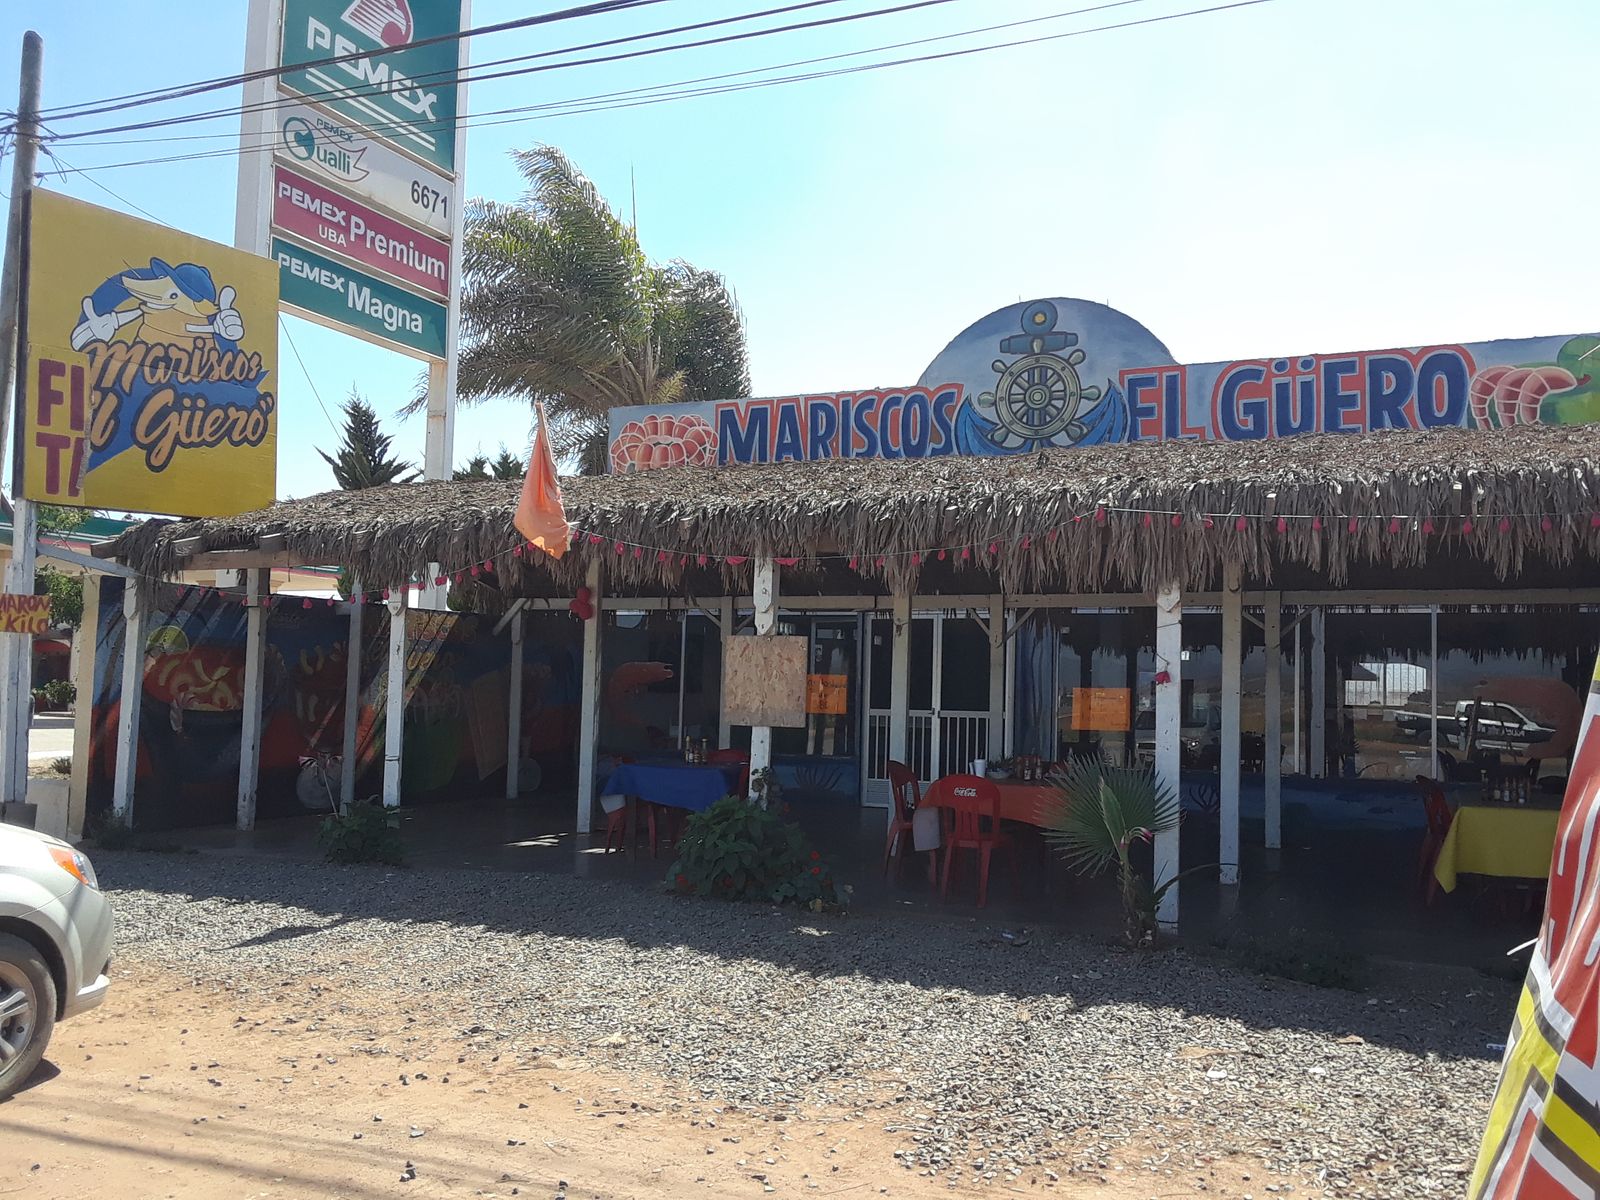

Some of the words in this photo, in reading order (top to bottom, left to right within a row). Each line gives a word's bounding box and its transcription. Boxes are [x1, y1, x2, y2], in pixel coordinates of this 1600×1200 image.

[307, 16, 437, 123] PEMEX
[316, 118, 354, 143] PEMEX
[278, 181, 347, 227] PEMEX
[350, 215, 446, 281] Premium
[318, 224, 347, 248] UBA
[411, 180, 449, 219] 6671
[278, 252, 345, 294] PEMEX
[347, 281, 423, 333] Magna
[716, 387, 961, 466] MARISCOS
[1123, 369, 1192, 442] EL
[1218, 350, 1470, 440] GÜERO
